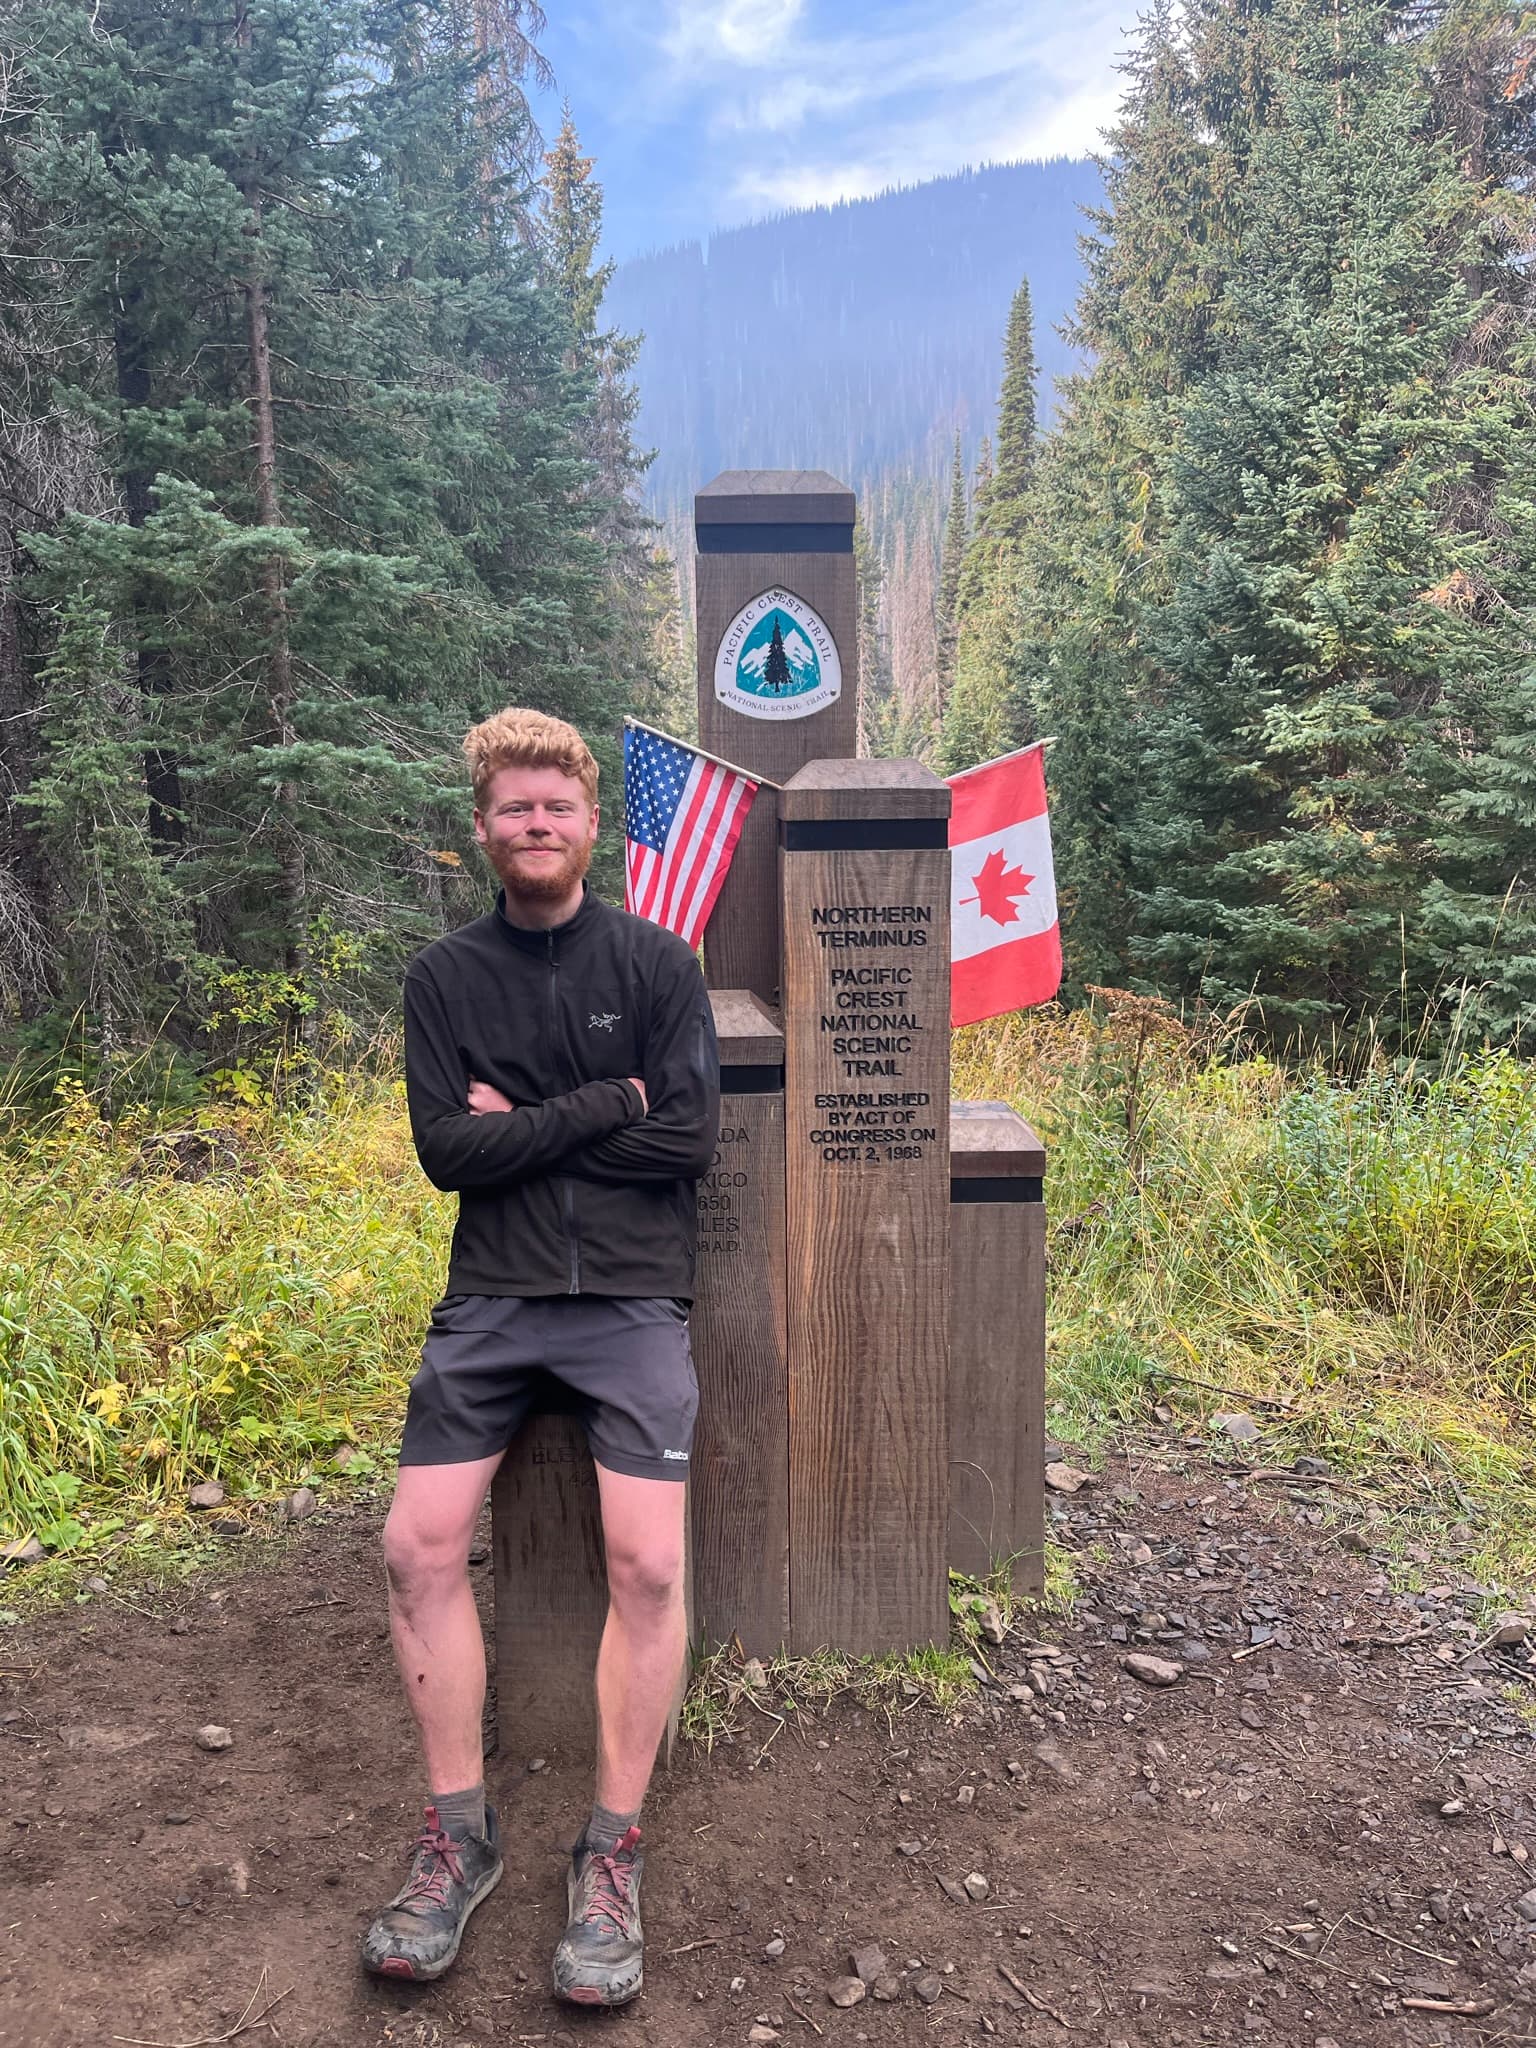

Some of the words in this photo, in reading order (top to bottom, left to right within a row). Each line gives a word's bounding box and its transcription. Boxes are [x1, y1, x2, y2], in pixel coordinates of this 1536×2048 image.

[723, 610, 755, 666] PACIFIC
[758, 593, 803, 614] CREST
[806, 617, 833, 662] TRAIL
[727, 690, 768, 712] NATIONAL
[770, 701, 801, 713] SCENIC
[812, 906, 931, 925] NORTHERN
[816, 930, 927, 948] TERMINUS
[831, 968, 912, 986] PACIFIC
[837, 991, 907, 1008] CREST
[821, 1014, 923, 1032] NATIONAL
[833, 1036, 912, 1054] SCENIC
[842, 1059, 903, 1077] TRAIL
[815, 1092, 930, 1108] ESTABLISHED
[828, 1111, 852, 1126] BY
[854, 1111, 889, 1126] ACT
[892, 1110, 916, 1124] OF
[809, 1128, 906, 1144] CONGRESS
[910, 1128, 936, 1142] ON
[823, 1147, 861, 1161] OCT.
[865, 1146, 881, 1162] 2,
[886, 1145, 922, 1160] 1968
[699, 1172, 748, 1188] XICO
[698, 1195, 731, 1211] 650
[696, 1217, 739, 1232] ILES
